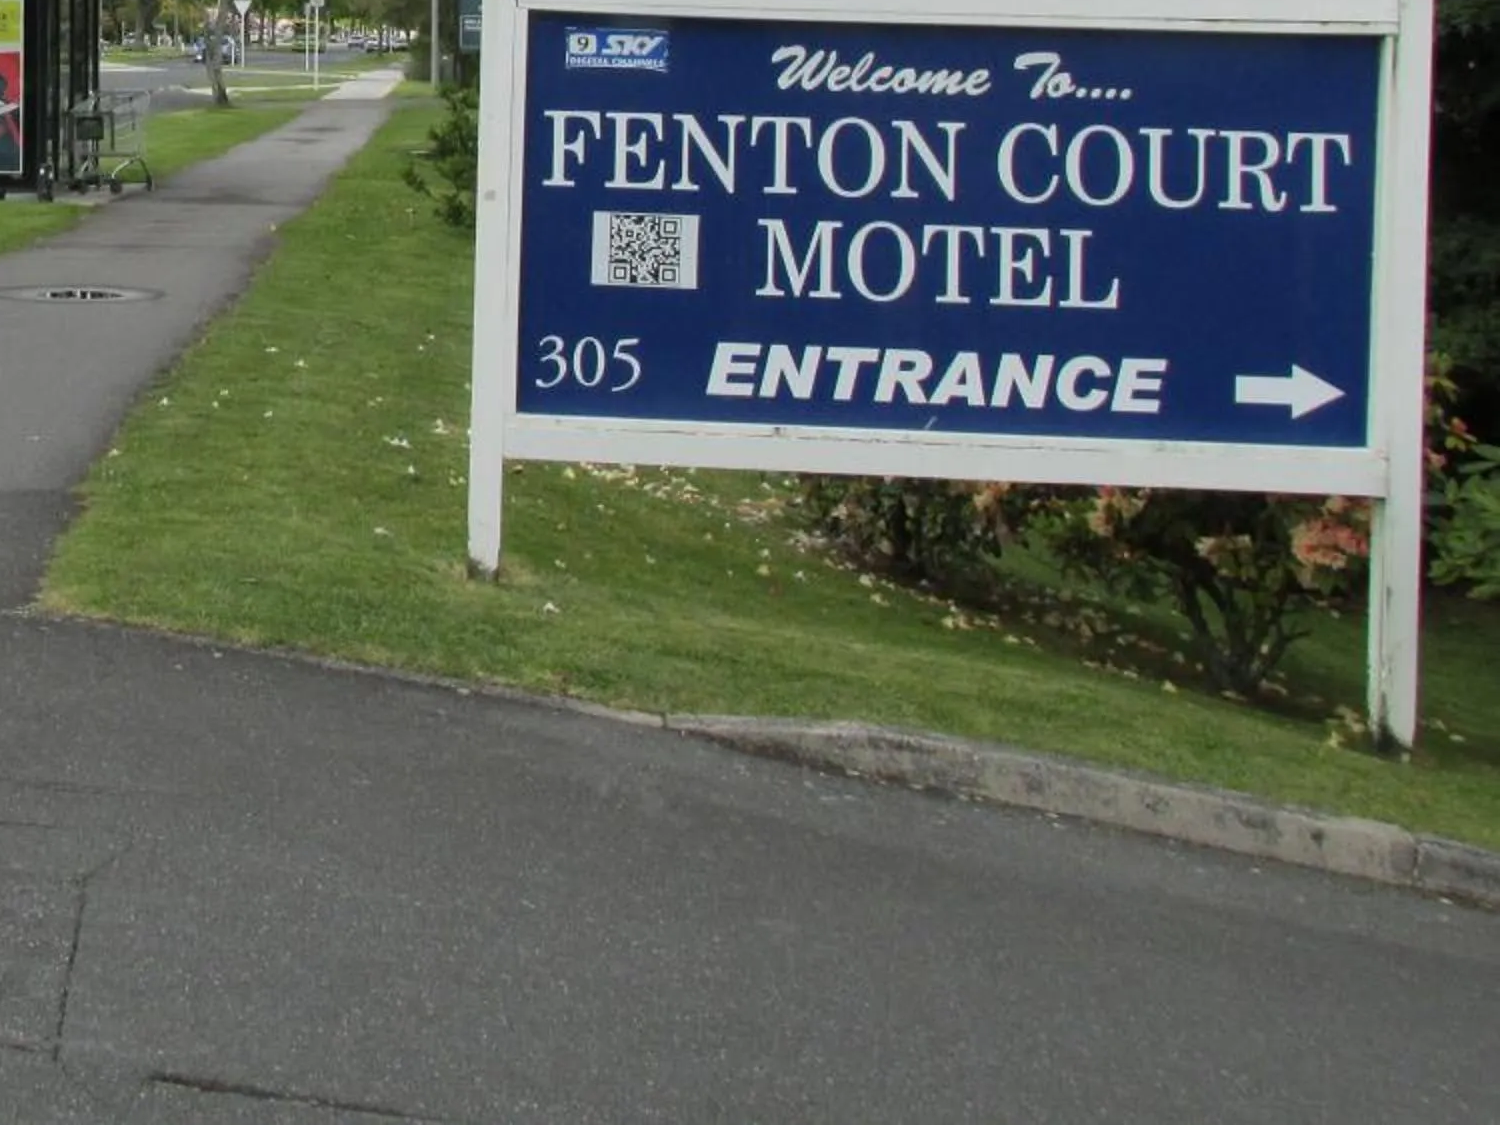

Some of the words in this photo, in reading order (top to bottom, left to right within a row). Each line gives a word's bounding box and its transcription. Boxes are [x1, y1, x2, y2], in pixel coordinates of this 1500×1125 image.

[601, 34, 663, 56] SKY
[771, 44, 992, 96] Welcome
[1013, 51, 1132, 100] To....
[542, 110, 966, 202] FENTON
[997, 122, 1351, 212] COURT
[755, 218, 1120, 309] MOTEL
[535, 335, 641, 392] 305
[705, 342, 1168, 414] ENTRANCE
